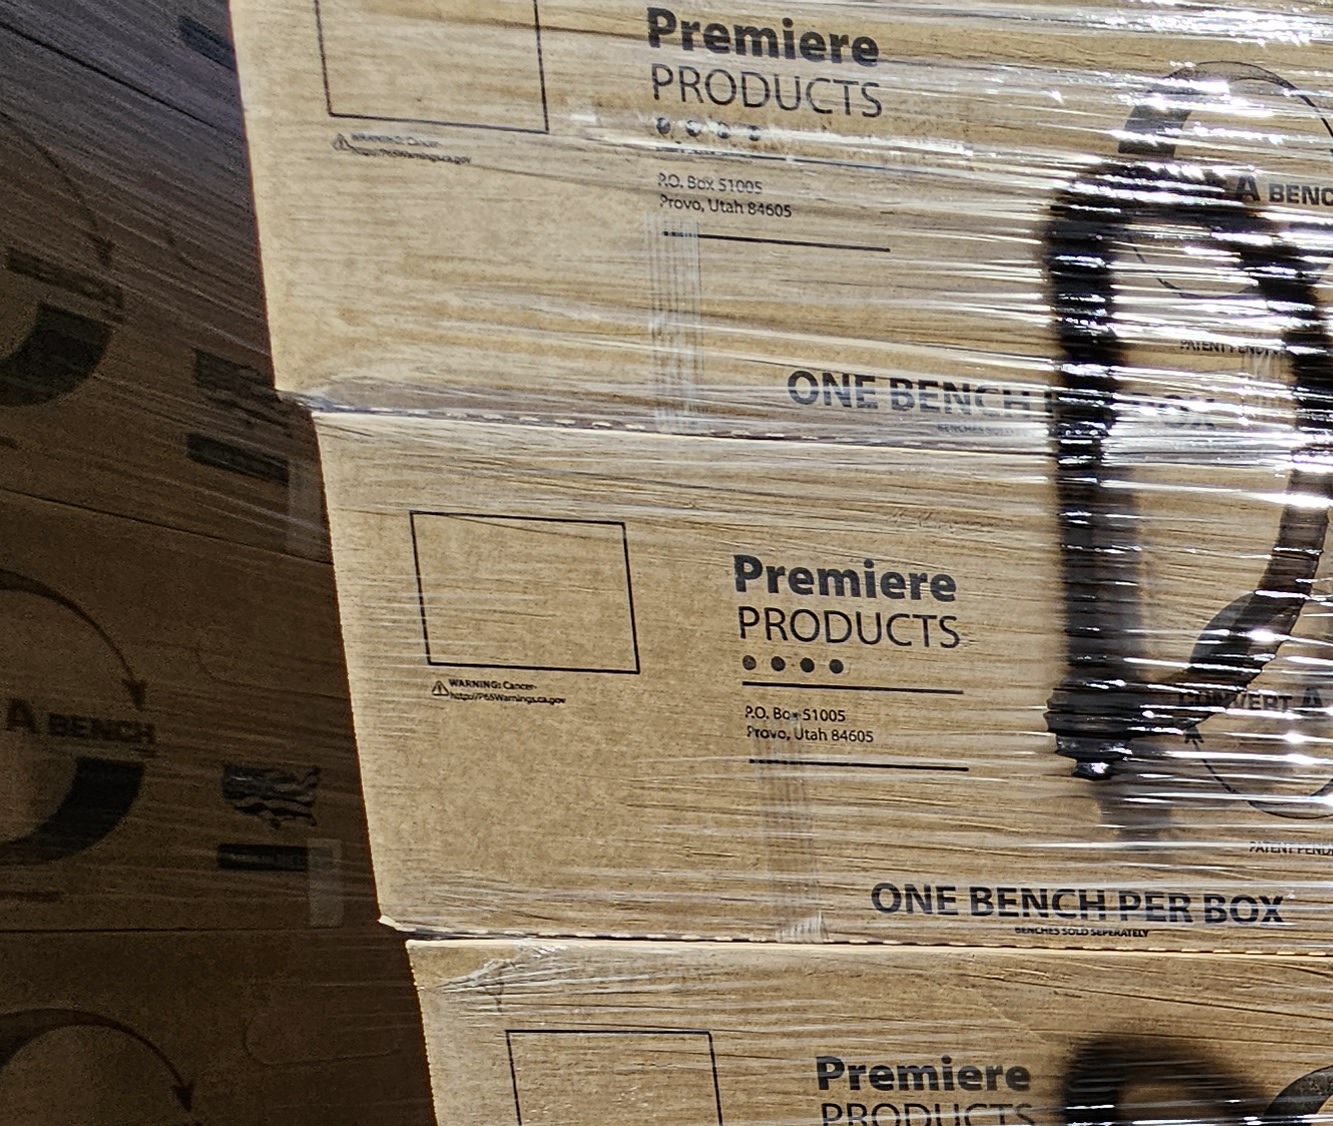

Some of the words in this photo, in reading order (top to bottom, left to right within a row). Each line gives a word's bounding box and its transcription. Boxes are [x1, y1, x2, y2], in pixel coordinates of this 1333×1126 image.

[647, 7, 879, 66] Premiere
[651, 65, 883, 119] PRODUCTS
[1235, 176, 1261, 201] A
[787, 370, 880, 411] ONE
[889, 376, 1032, 419] BENCH
[734, 553, 957, 602] Premiere
[738, 605, 962, 649] PRODUCTS
[773, 706, 799, 721] Box
[803, 708, 846, 722] 51005
[794, 727, 827, 742] Utah
[831, 728, 874, 743] 84605
[872, 883, 957, 916] ONE
[970, 886, 1106, 920] BENCH
[1120, 891, 1194, 924] PER
[1204, 895, 1285, 926] BOX
[817, 1055, 1030, 1092] Premiere
